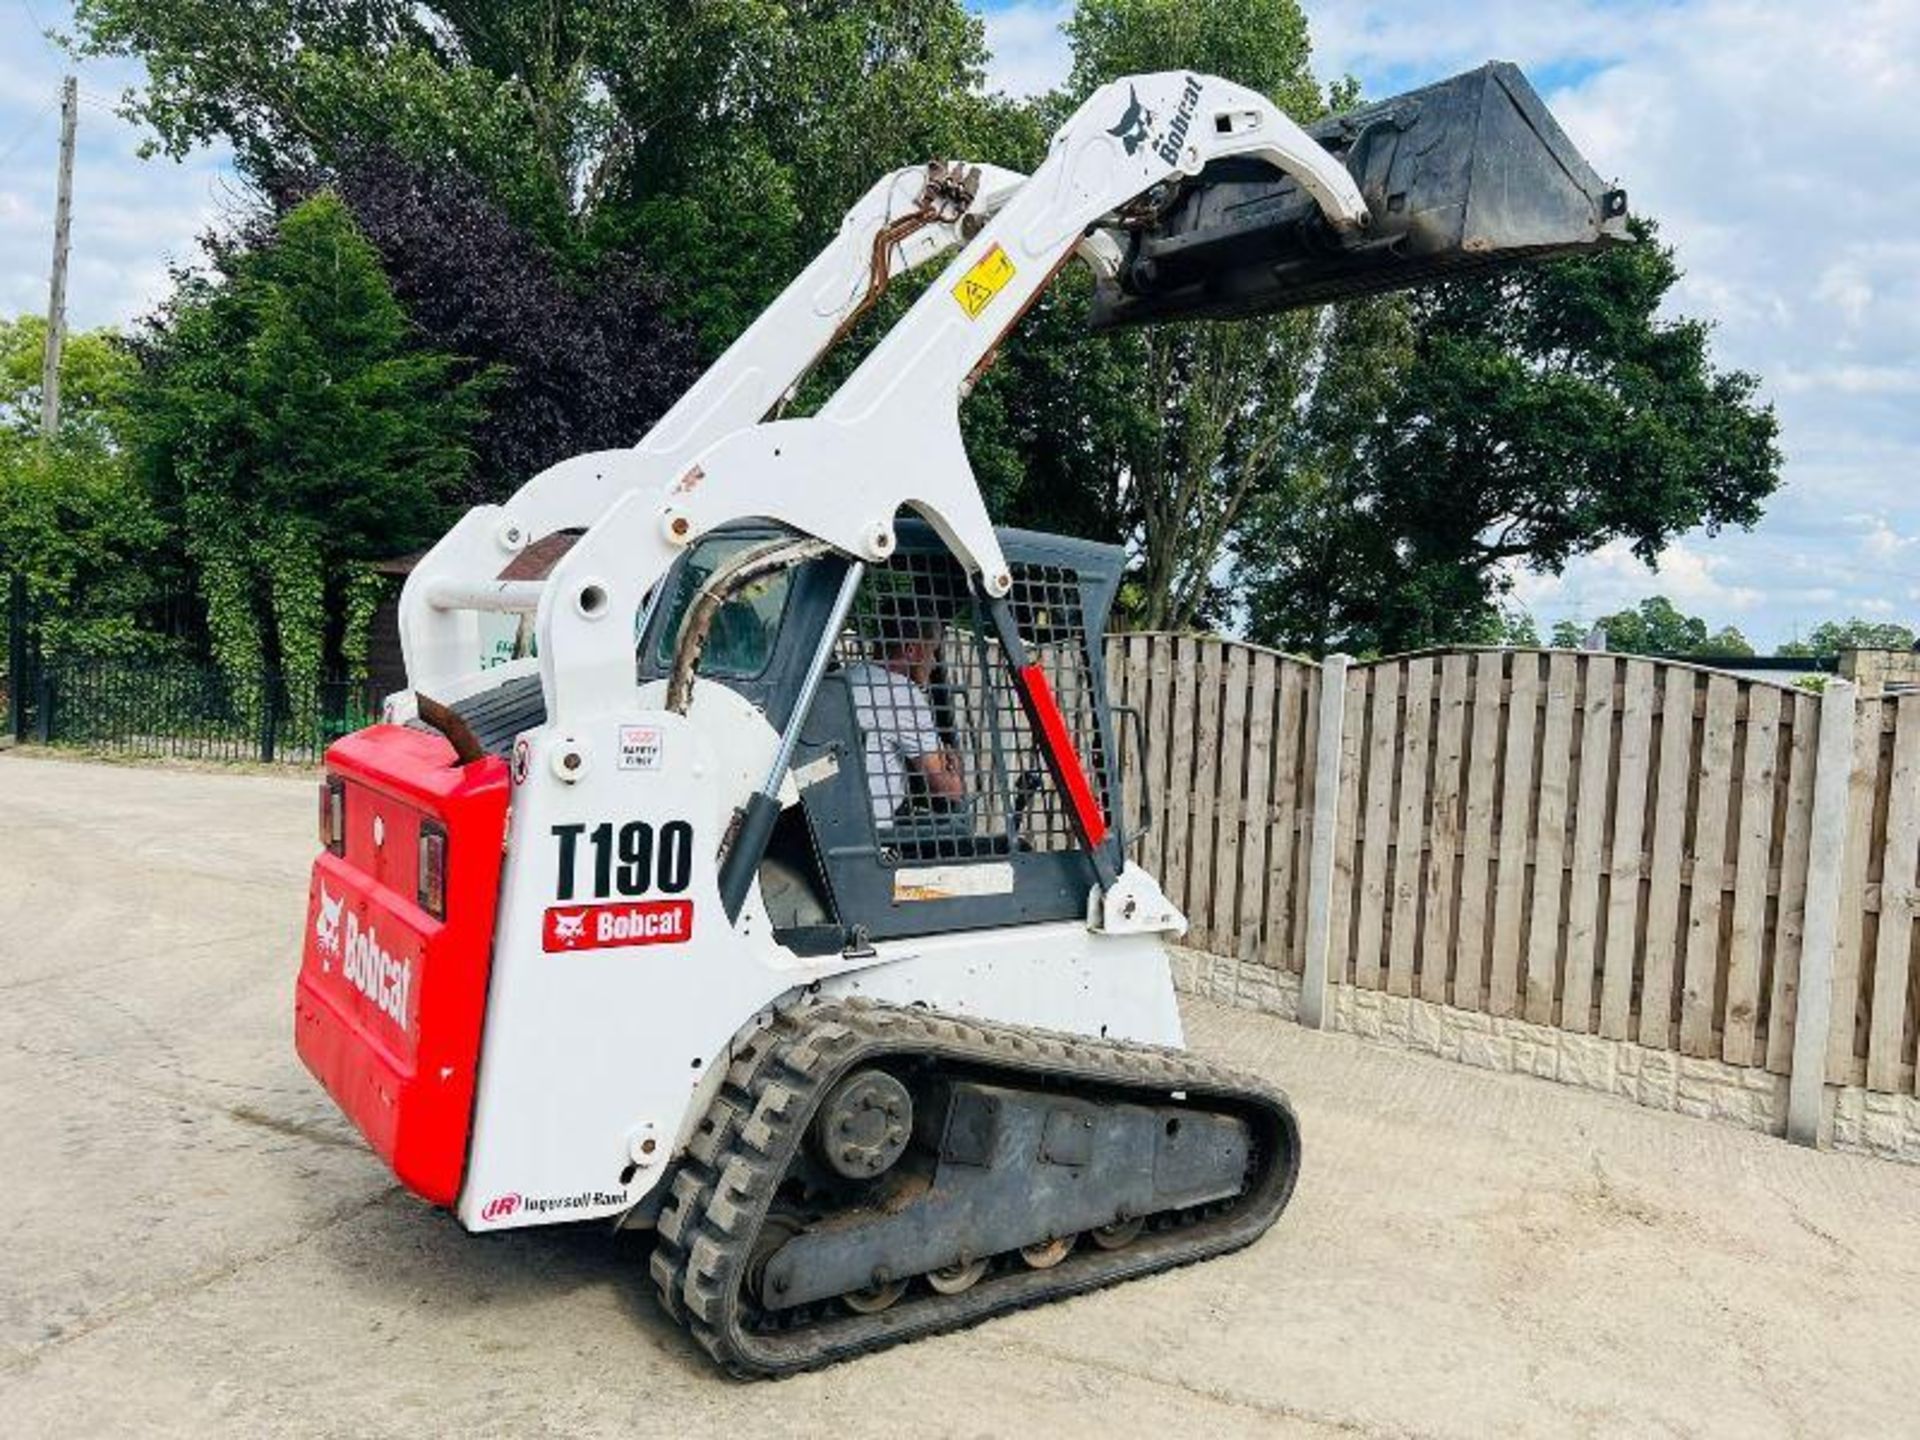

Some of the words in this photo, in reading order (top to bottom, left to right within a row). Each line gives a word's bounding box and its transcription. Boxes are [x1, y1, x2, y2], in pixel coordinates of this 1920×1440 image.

[1159, 76, 1203, 168] Bobcat
[551, 820, 693, 900] T190
[597, 908, 682, 942] Bobcat
[343, 911, 411, 1031] Bobcat
